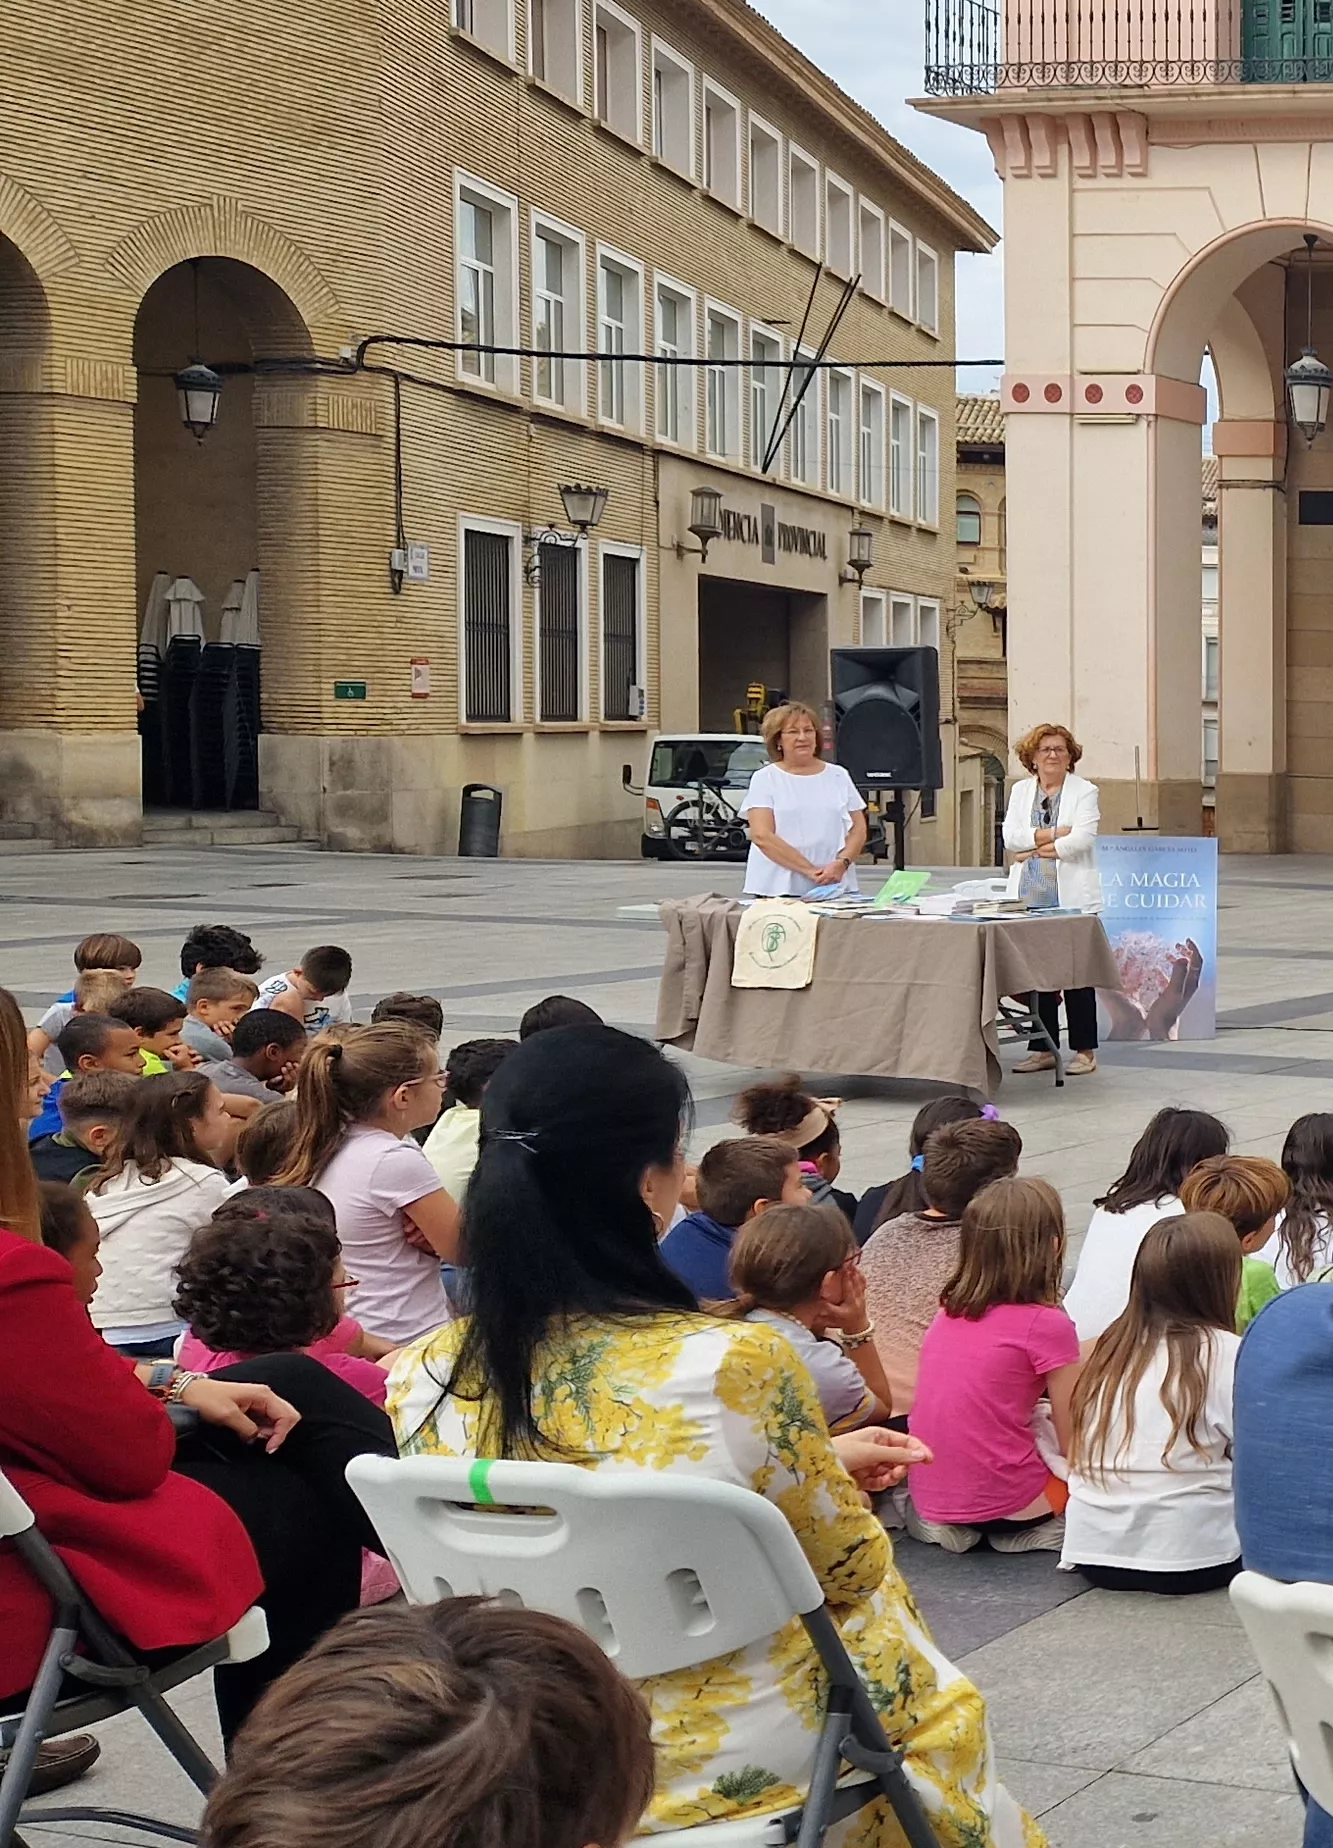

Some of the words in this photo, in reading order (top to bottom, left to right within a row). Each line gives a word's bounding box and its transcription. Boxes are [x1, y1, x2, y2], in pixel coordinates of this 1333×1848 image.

[1098, 872, 1124, 887] LA
[1130, 872, 1201, 888] MAGIA
[1101, 893, 1118, 908] E
[1125, 893, 1208, 909] CUIDAR
